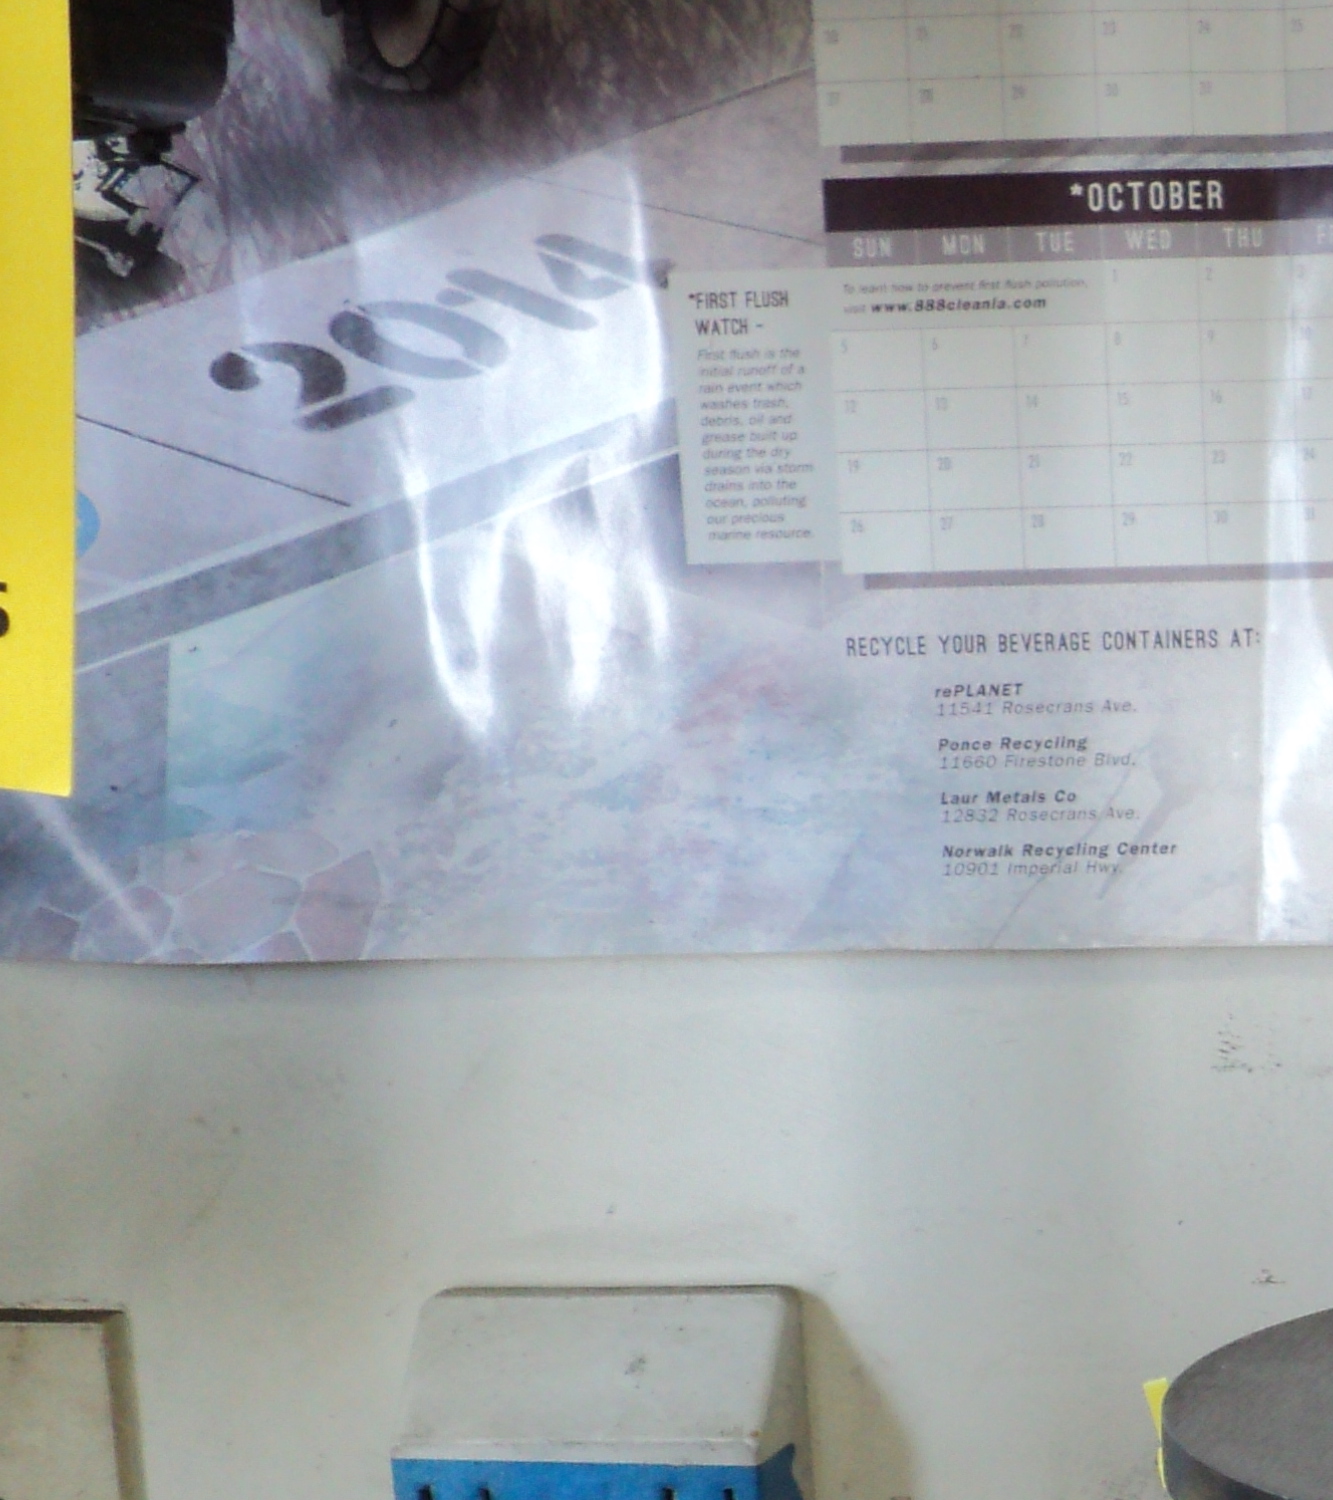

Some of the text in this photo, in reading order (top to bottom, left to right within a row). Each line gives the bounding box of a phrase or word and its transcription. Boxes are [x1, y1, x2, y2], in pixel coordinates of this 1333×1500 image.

[852, 236, 892, 259] SUN
[942, 233, 987, 256] MON
[1034, 231, 1075, 254] TUE
[1124, 228, 1172, 251] WED
[1223, 226, 1263, 249] THU
[745, 290, 789, 308] FLUSH
[695, 318, 748, 336] WATCH
[846, 627, 1262, 657] RECYCLE YOUR BEVERAGE CONTAINERS AT:
[934, 683, 1024, 699] rePLANET
[937, 699, 1138, 716] 11541 Rosecrans Ave.
[938, 736, 1089, 753] Ponce Recycling
[938, 752, 1137, 770] 11660 Firestone Blvd.
[940, 789, 1078, 806] Laur Metals Co
[941, 806, 1141, 823] 12832 Rosecrans Ave.
[942, 841, 1178, 860] Norwalk Recycling Center
[942, 861, 999, 877] 10901
[1006, 859, 1079, 878] Imperial
